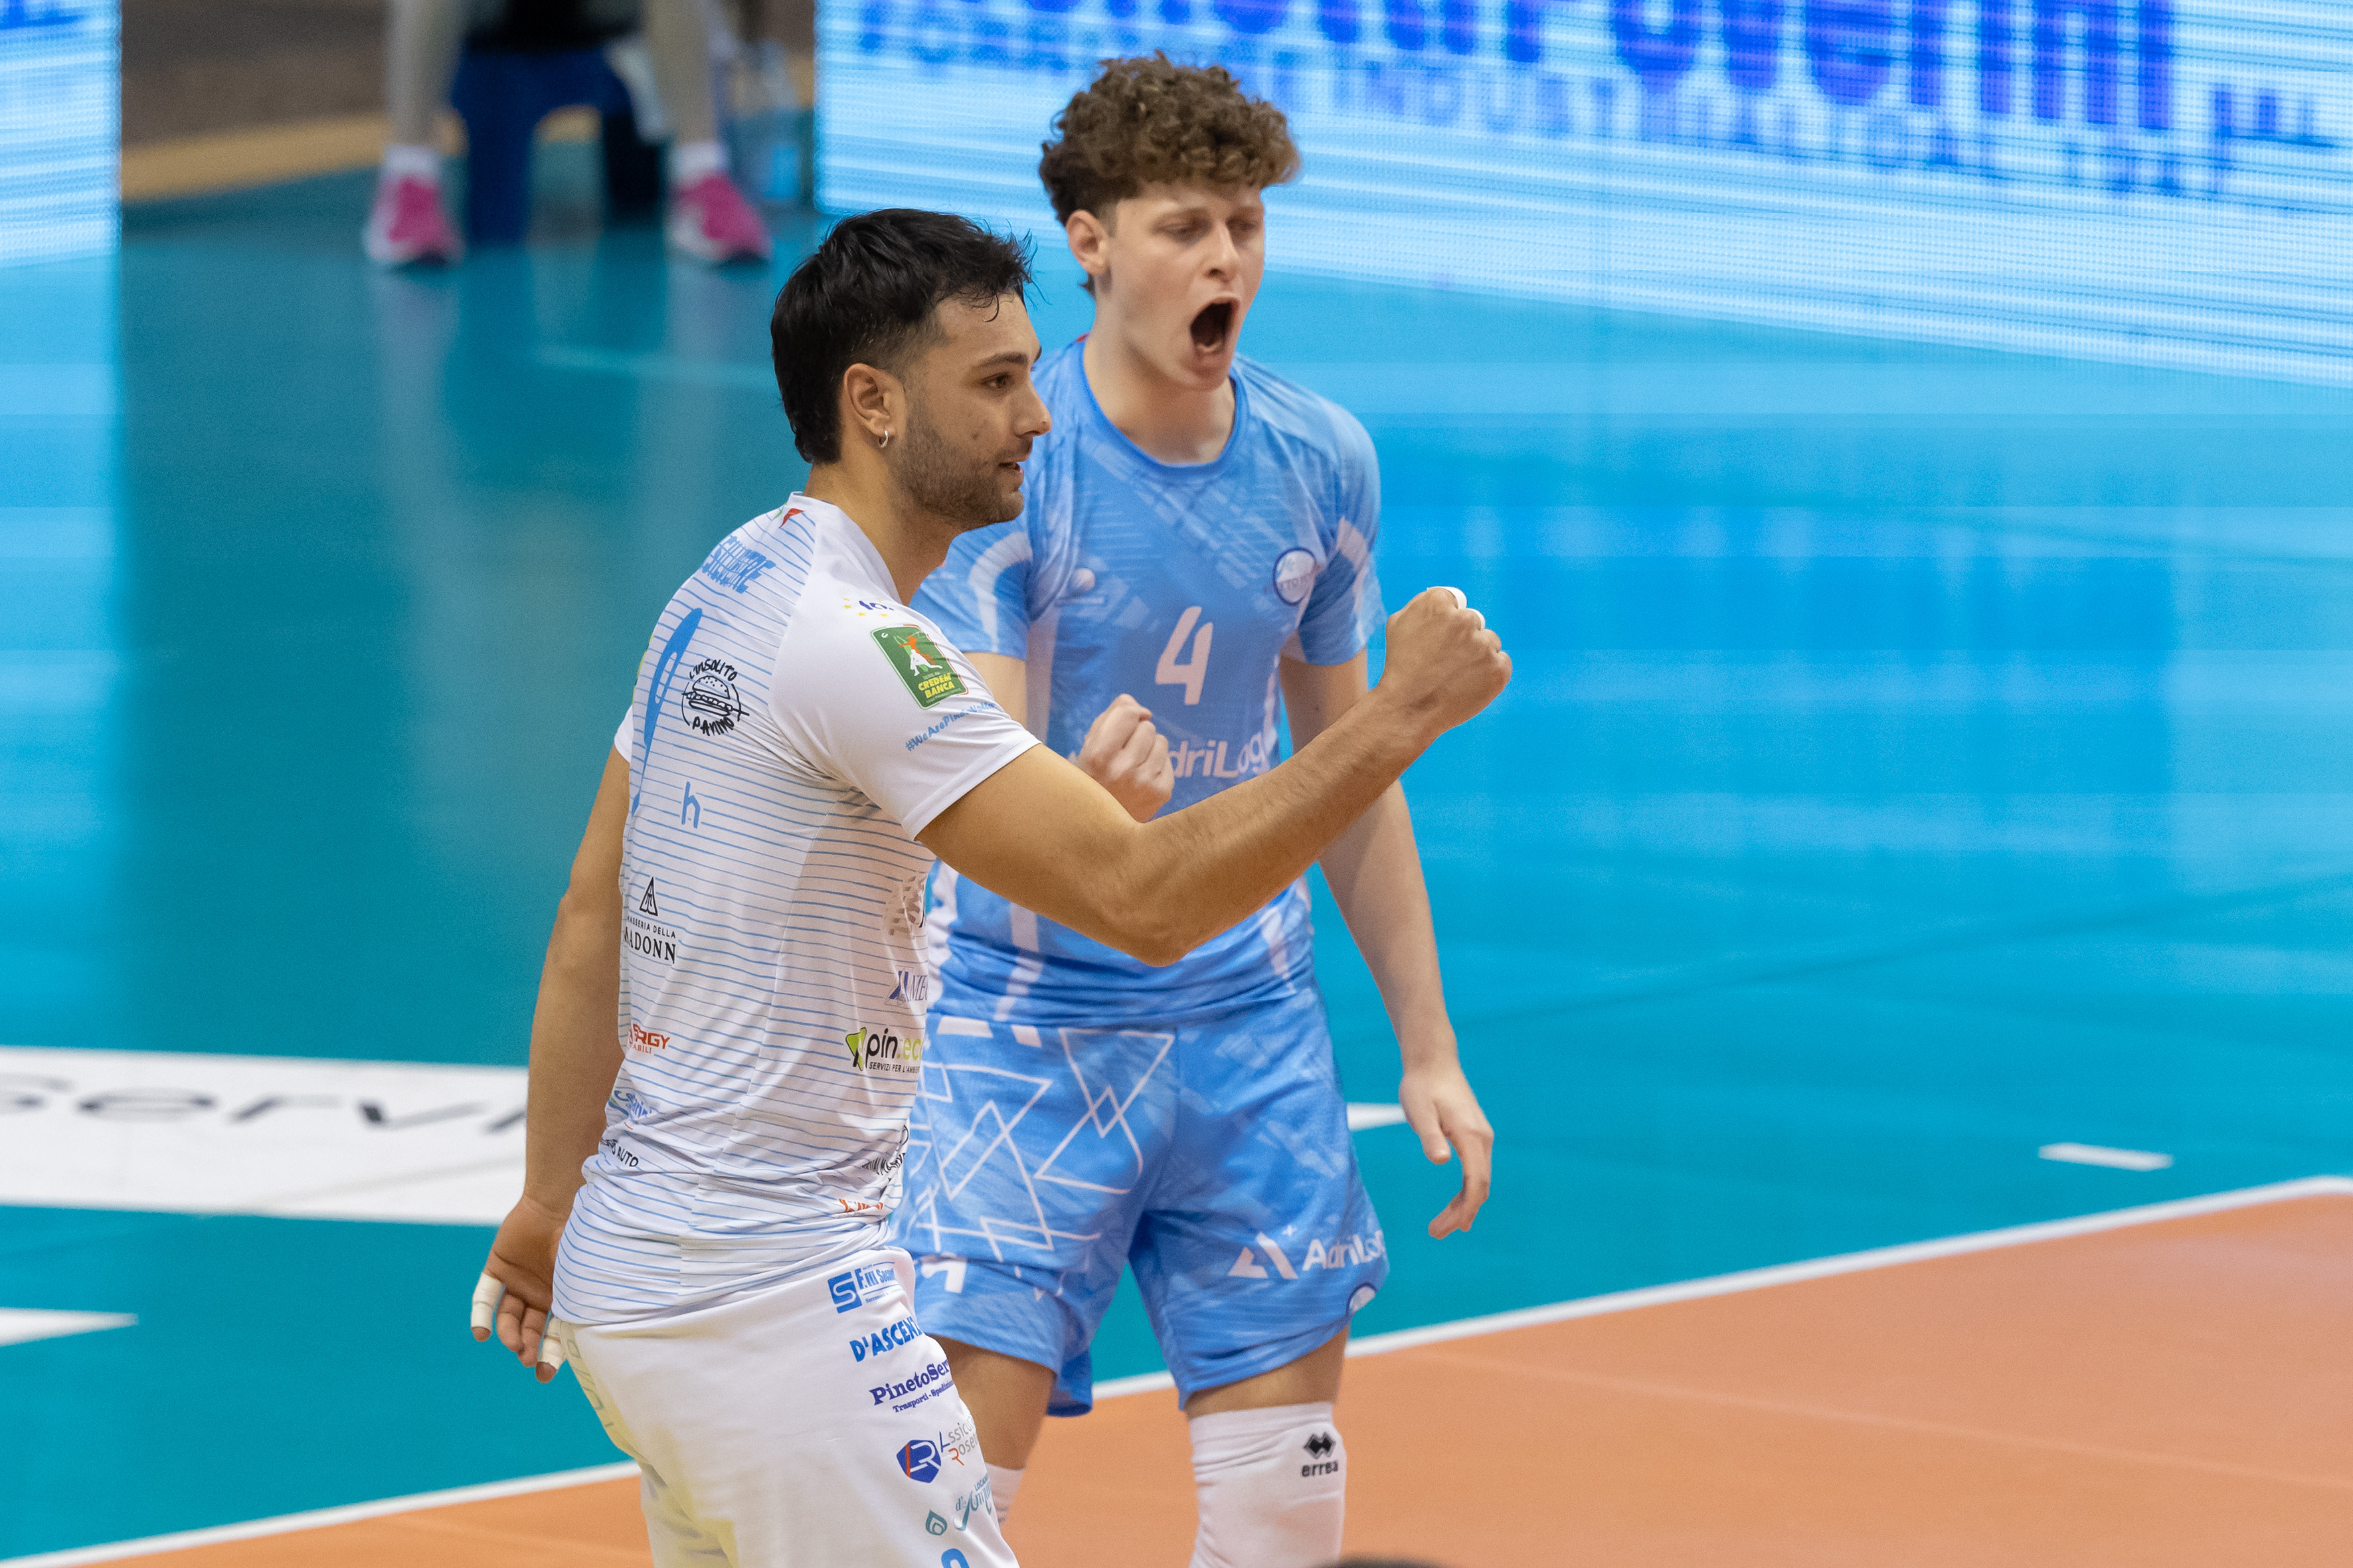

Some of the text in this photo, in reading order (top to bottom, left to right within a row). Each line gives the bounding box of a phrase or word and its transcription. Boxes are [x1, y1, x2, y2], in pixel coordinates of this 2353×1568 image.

[1156, 606, 1213, 705] 4
[918, 673, 952, 691] CREDEM
[924, 681, 955, 699] BANCA
[654, 925, 676, 939] DELLA
[865, 1028, 923, 1068] pin.ec
[893, 1393, 929, 1413] Trasporti
